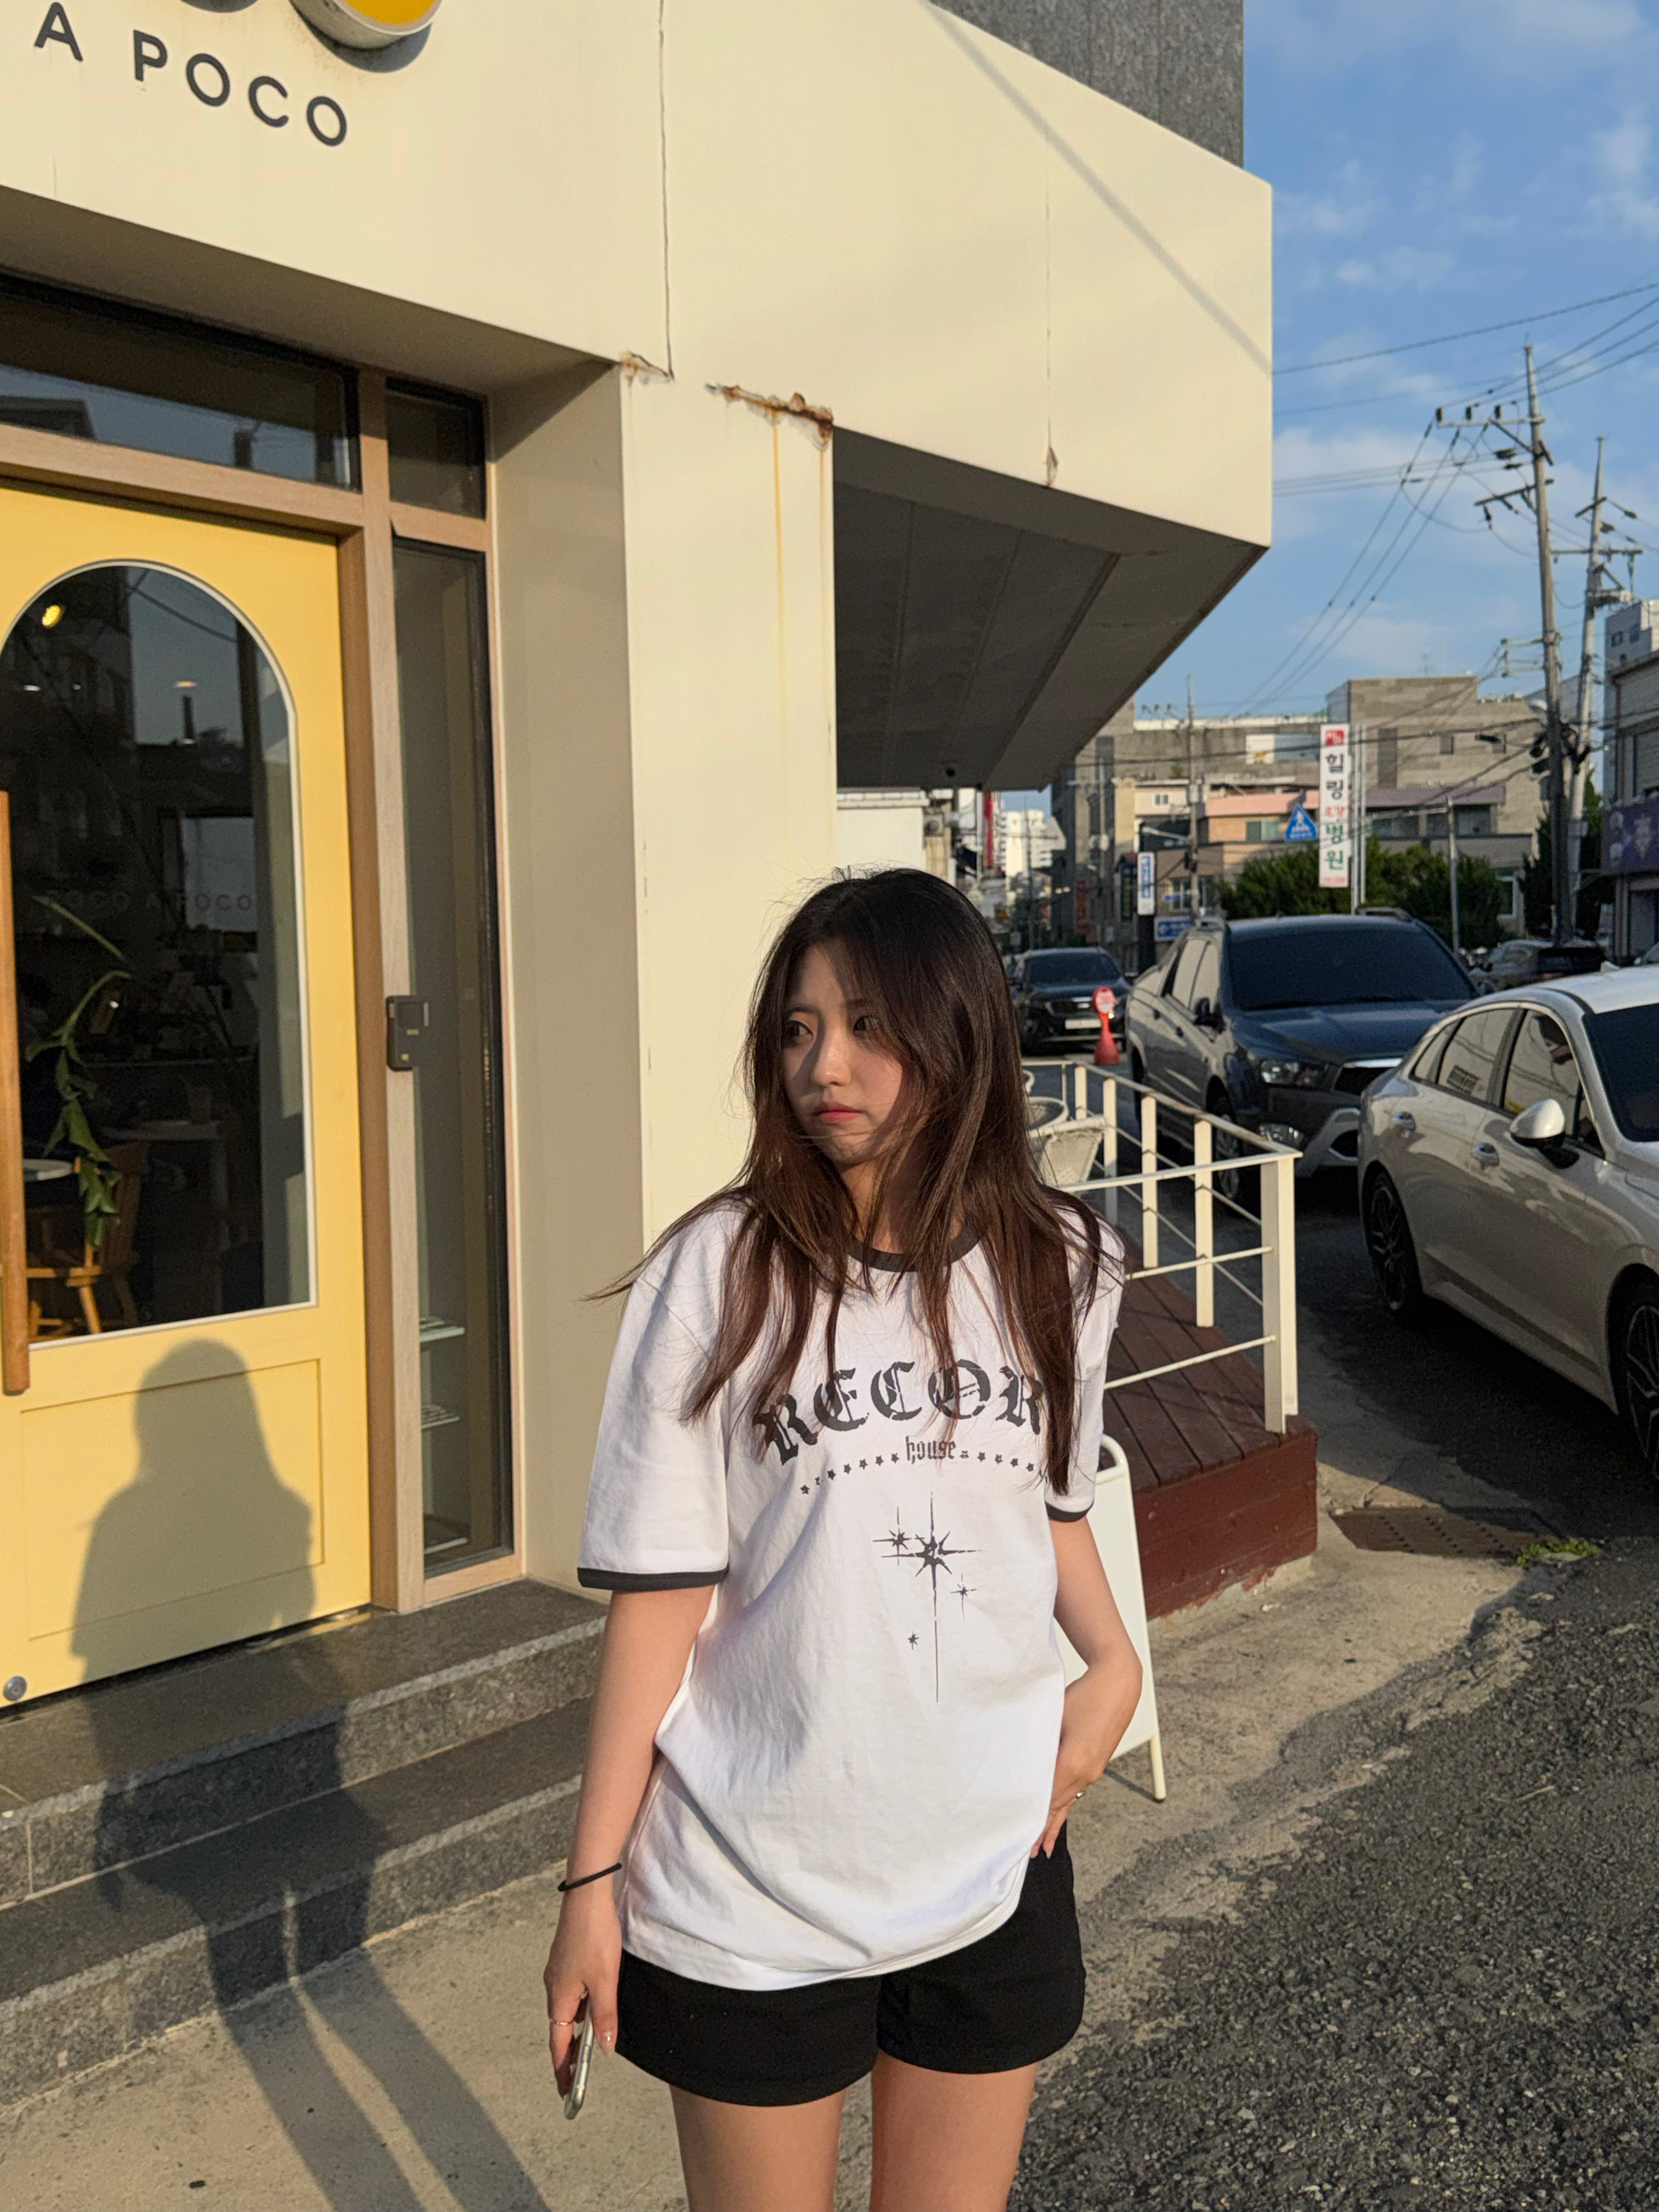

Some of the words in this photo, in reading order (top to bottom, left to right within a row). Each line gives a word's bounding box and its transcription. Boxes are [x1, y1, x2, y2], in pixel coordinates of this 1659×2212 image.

[34, 2, 83, 62] A
[133, 30, 348, 147] POCO
[752, 1358, 1044, 1466] RECOR
[905, 1435, 957, 1465] house
